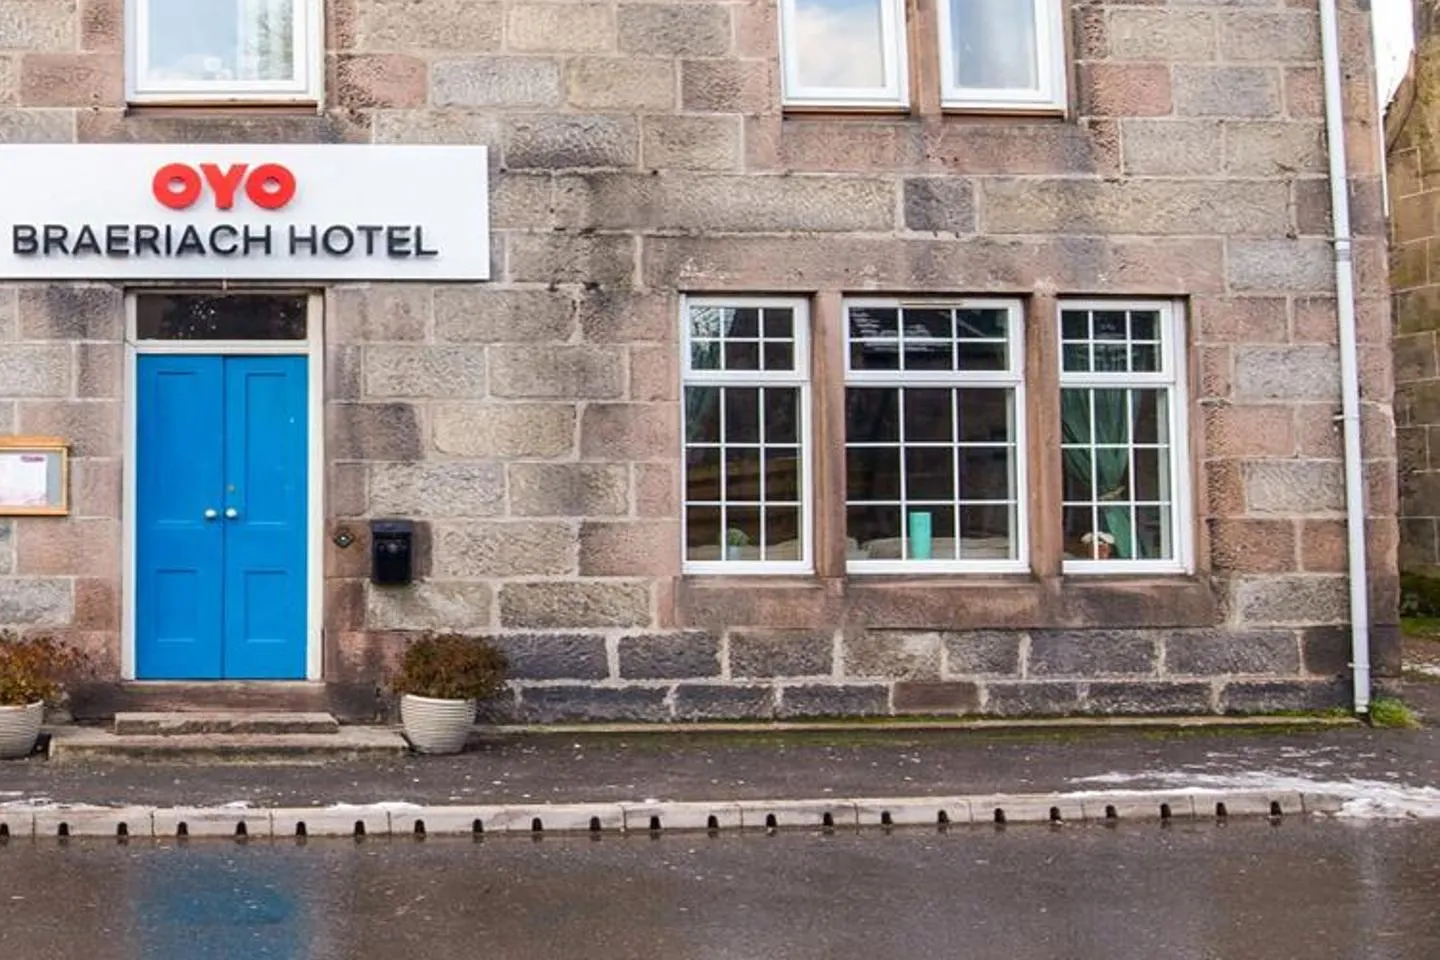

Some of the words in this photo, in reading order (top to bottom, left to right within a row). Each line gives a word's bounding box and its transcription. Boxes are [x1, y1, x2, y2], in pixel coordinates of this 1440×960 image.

[152, 163, 296, 210] OYO
[12, 224, 270, 256] BRAERIACH
[289, 224, 438, 257] HOTEL
